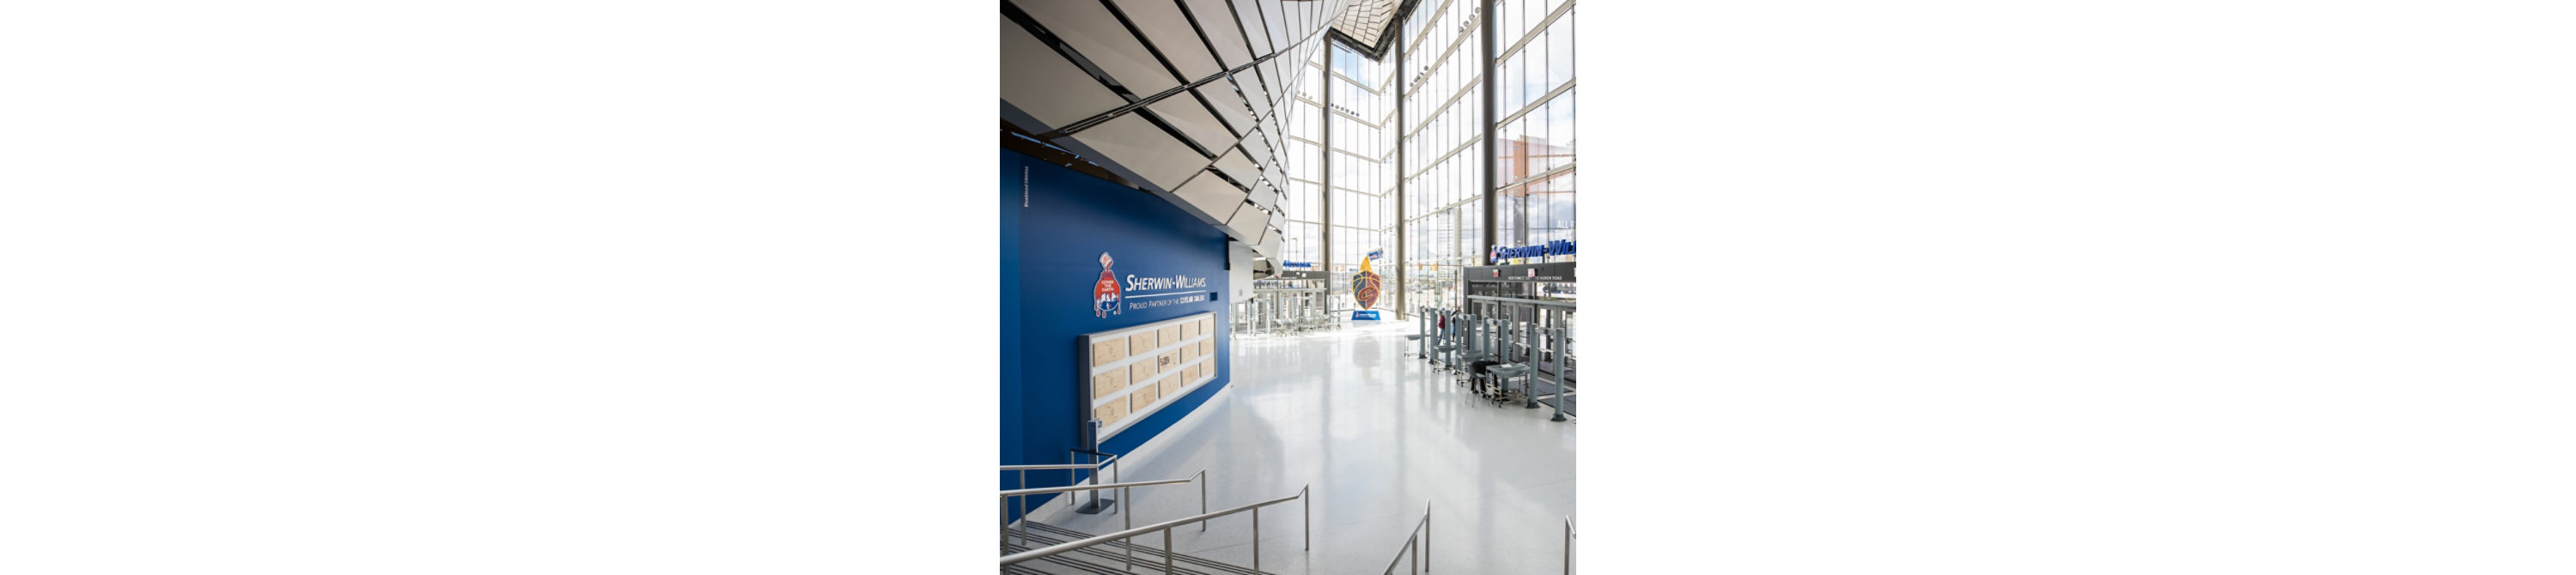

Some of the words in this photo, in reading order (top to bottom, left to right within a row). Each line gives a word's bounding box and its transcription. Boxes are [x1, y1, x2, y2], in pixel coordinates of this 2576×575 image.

[1125, 275, 1206, 291] SHERWIN-WILLIAMS
[1129, 301, 1148, 311] PROUD
[1148, 299, 1167, 308] PARTNER
